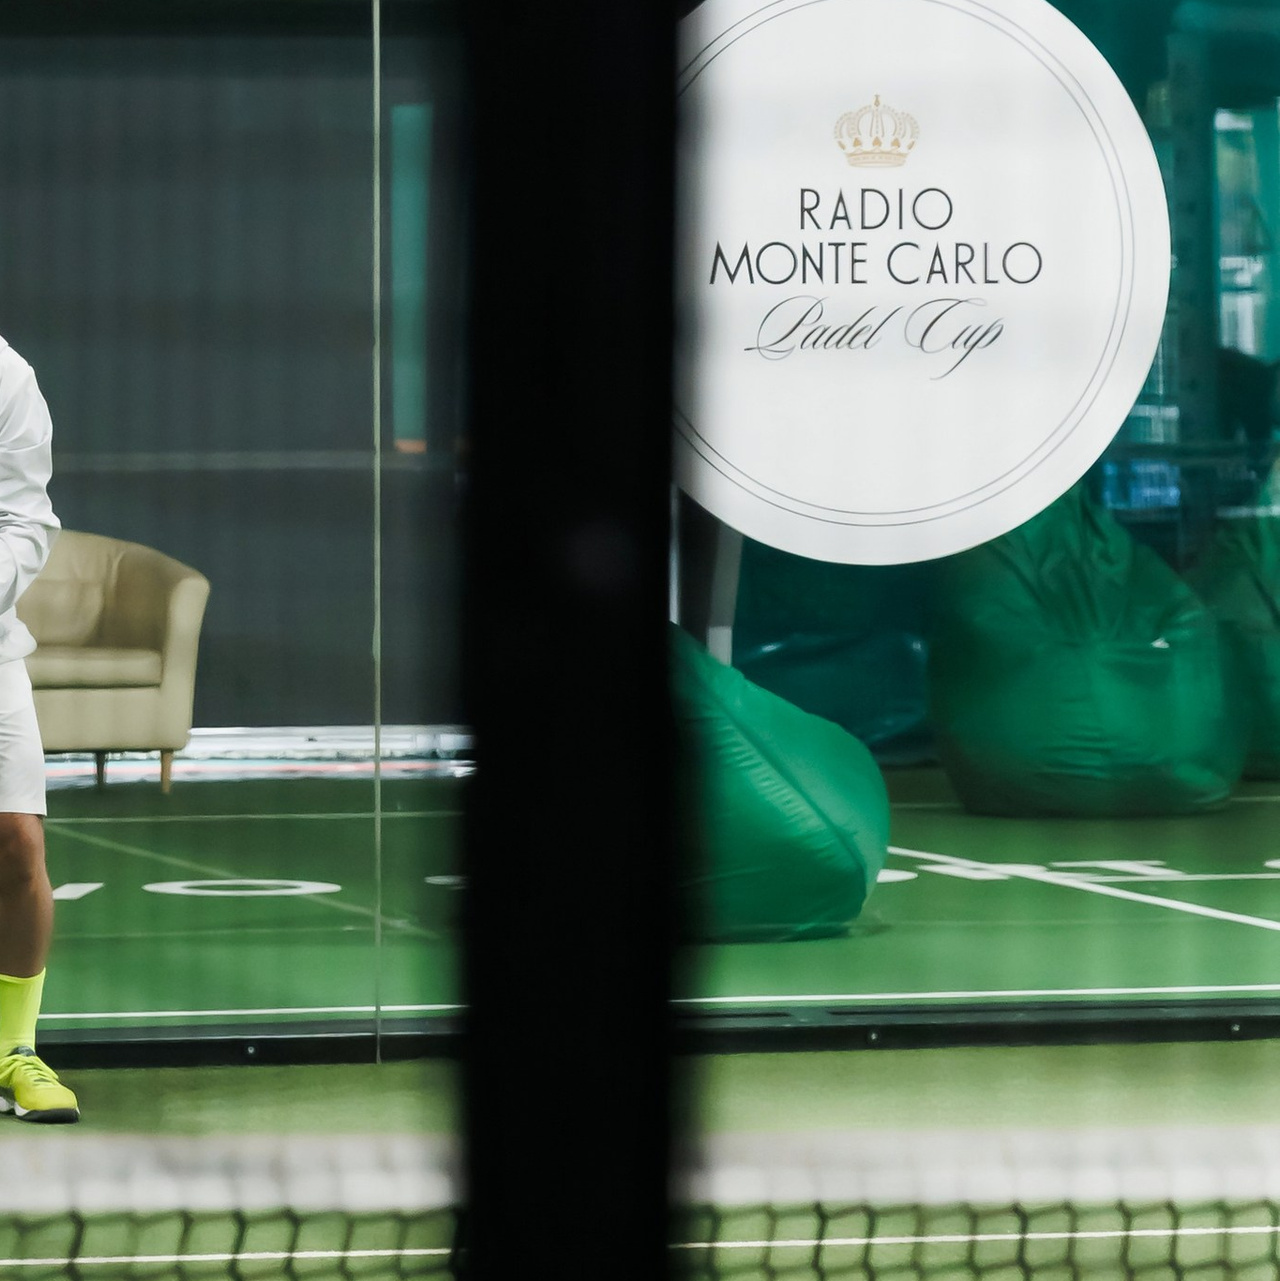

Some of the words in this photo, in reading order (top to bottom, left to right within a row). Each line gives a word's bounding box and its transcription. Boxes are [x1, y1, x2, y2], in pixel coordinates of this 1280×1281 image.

[800, 187, 954, 231] RADIO
[709, 242, 868, 285] MONTE
[887, 242, 1043, 285] CARLO
[744, 296, 903, 361] Padel
[904, 297, 1005, 381] Cup
